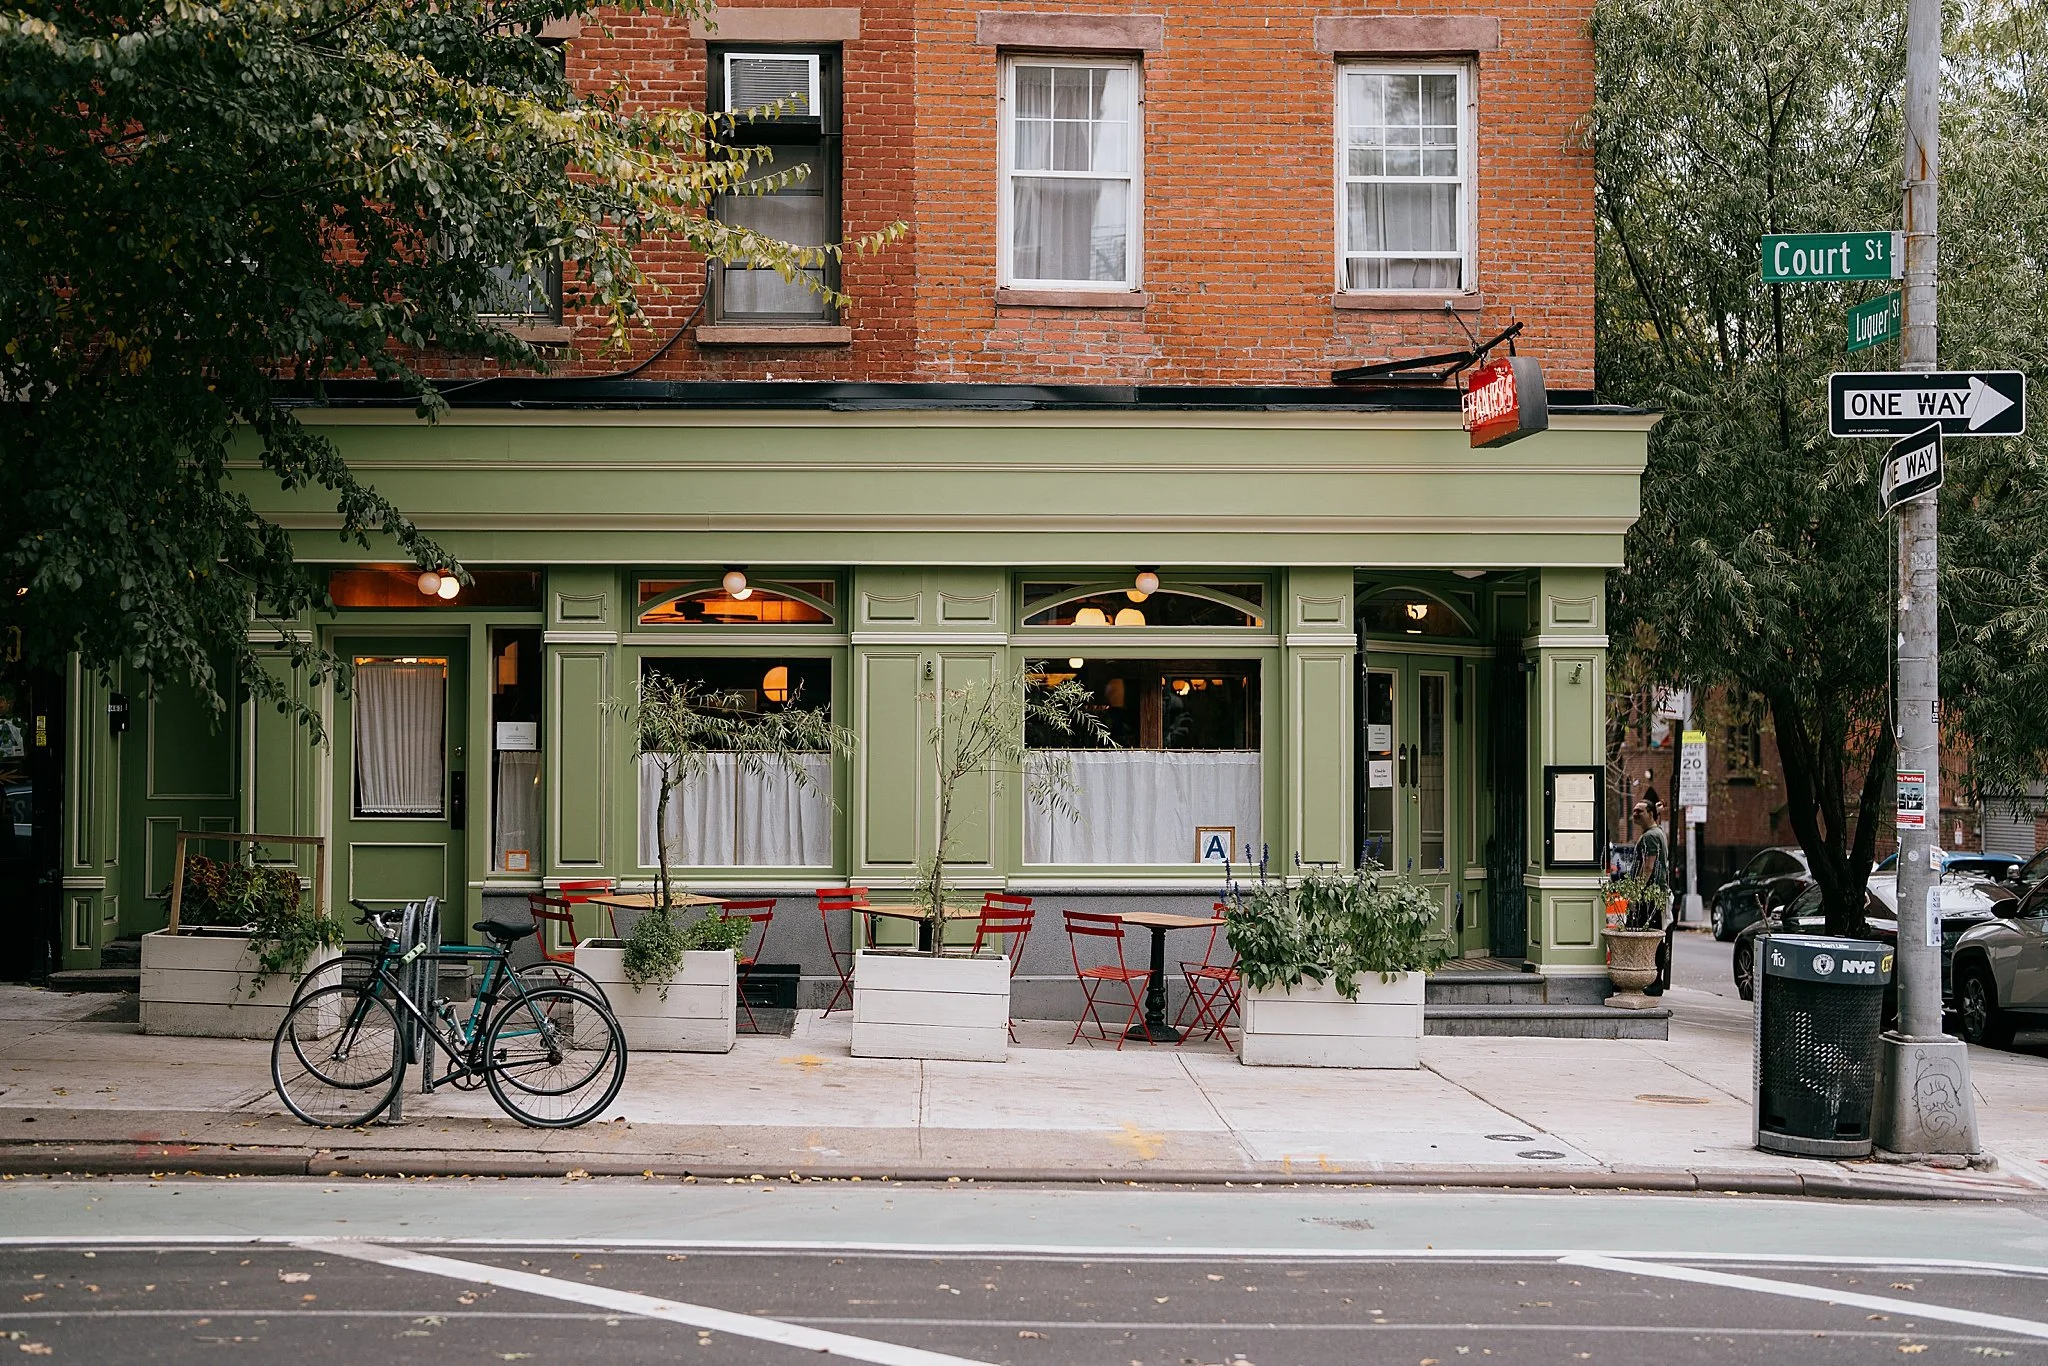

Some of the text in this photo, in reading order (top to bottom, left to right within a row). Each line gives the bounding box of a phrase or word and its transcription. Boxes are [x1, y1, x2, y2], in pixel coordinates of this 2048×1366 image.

[1774, 239, 1884, 276] Court St
[1856, 299, 1900, 346] Luquer St
[1851, 392, 1971, 416] ONE WAY
[1906, 446, 1933, 479] WAY
[1683, 758, 1702, 769] 20
[1904, 775, 1923, 783] Parking
[1204, 835, 1226, 858] A
[1841, 959, 1876, 974] NYC
